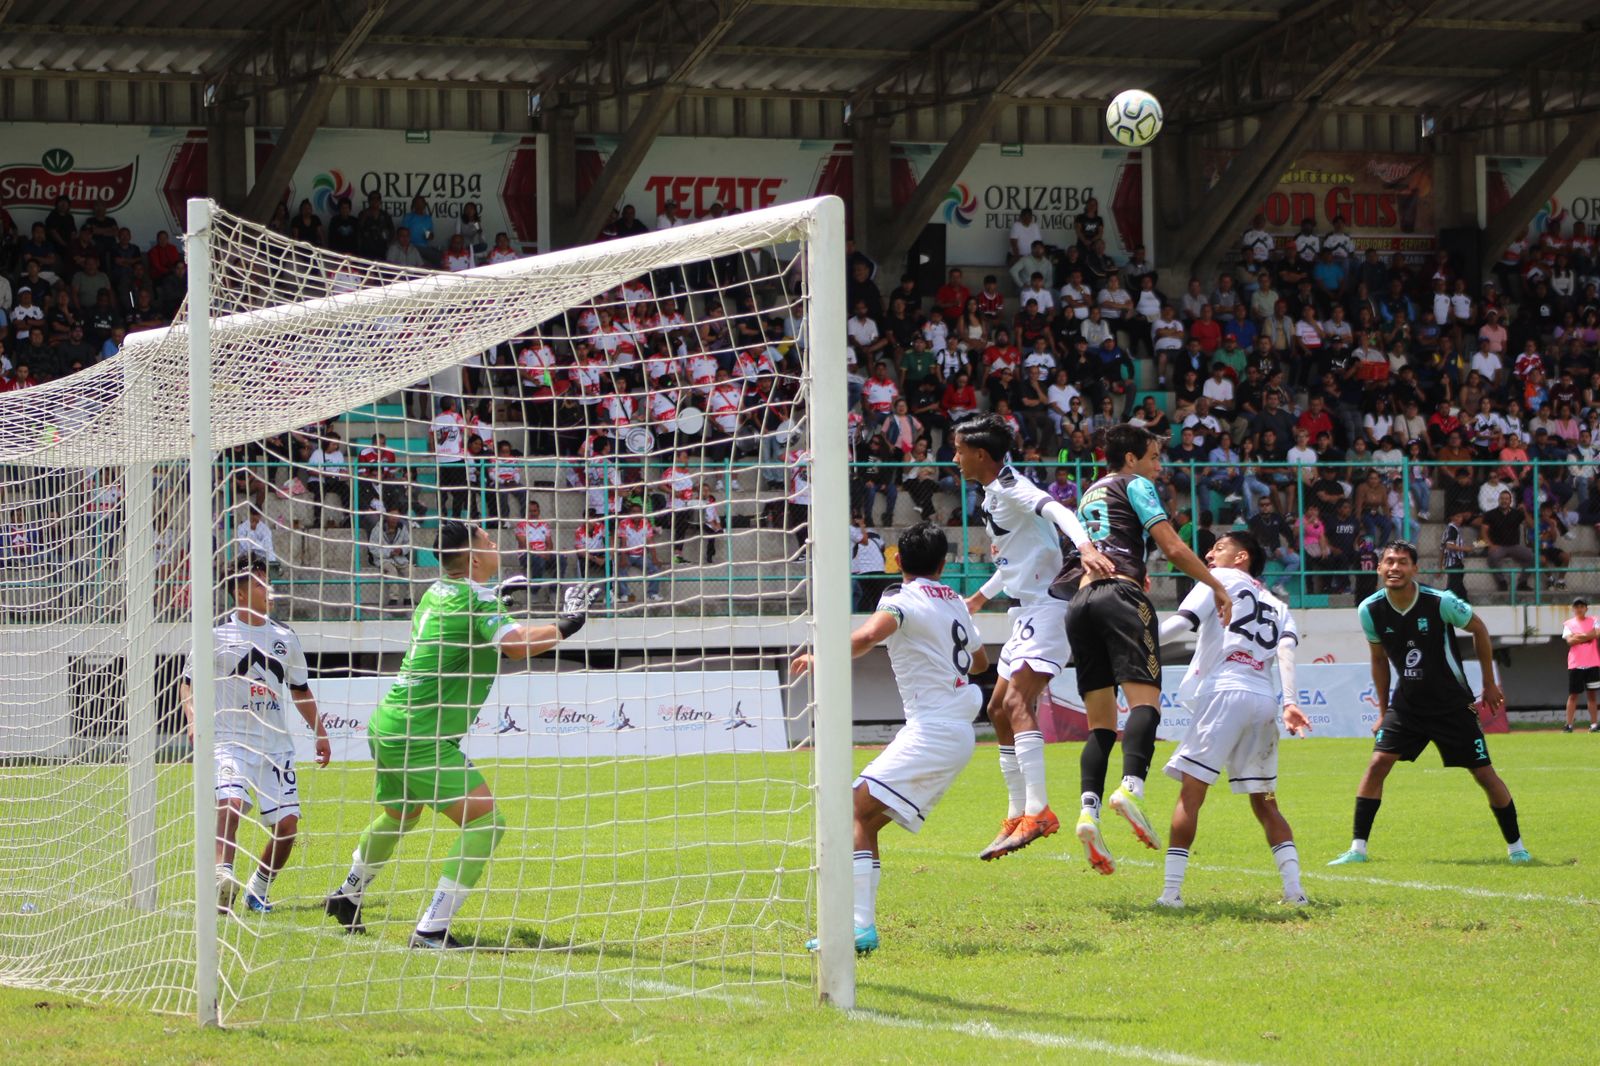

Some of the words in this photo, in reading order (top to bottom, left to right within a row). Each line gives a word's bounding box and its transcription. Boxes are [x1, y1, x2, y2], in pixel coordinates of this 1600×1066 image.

[1, 177, 115, 201] Schettino
[644, 176, 784, 220] TECATE
[1255, 192, 1316, 227] on
[1324, 186, 1398, 227] Gus
[1228, 589, 1279, 650] 25
[951, 619, 971, 676] 8
[544, 706, 595, 724] Astro
[662, 704, 712, 721] Astro
[1473, 738, 1485, 753] 3
[272, 760, 297, 787] 16
